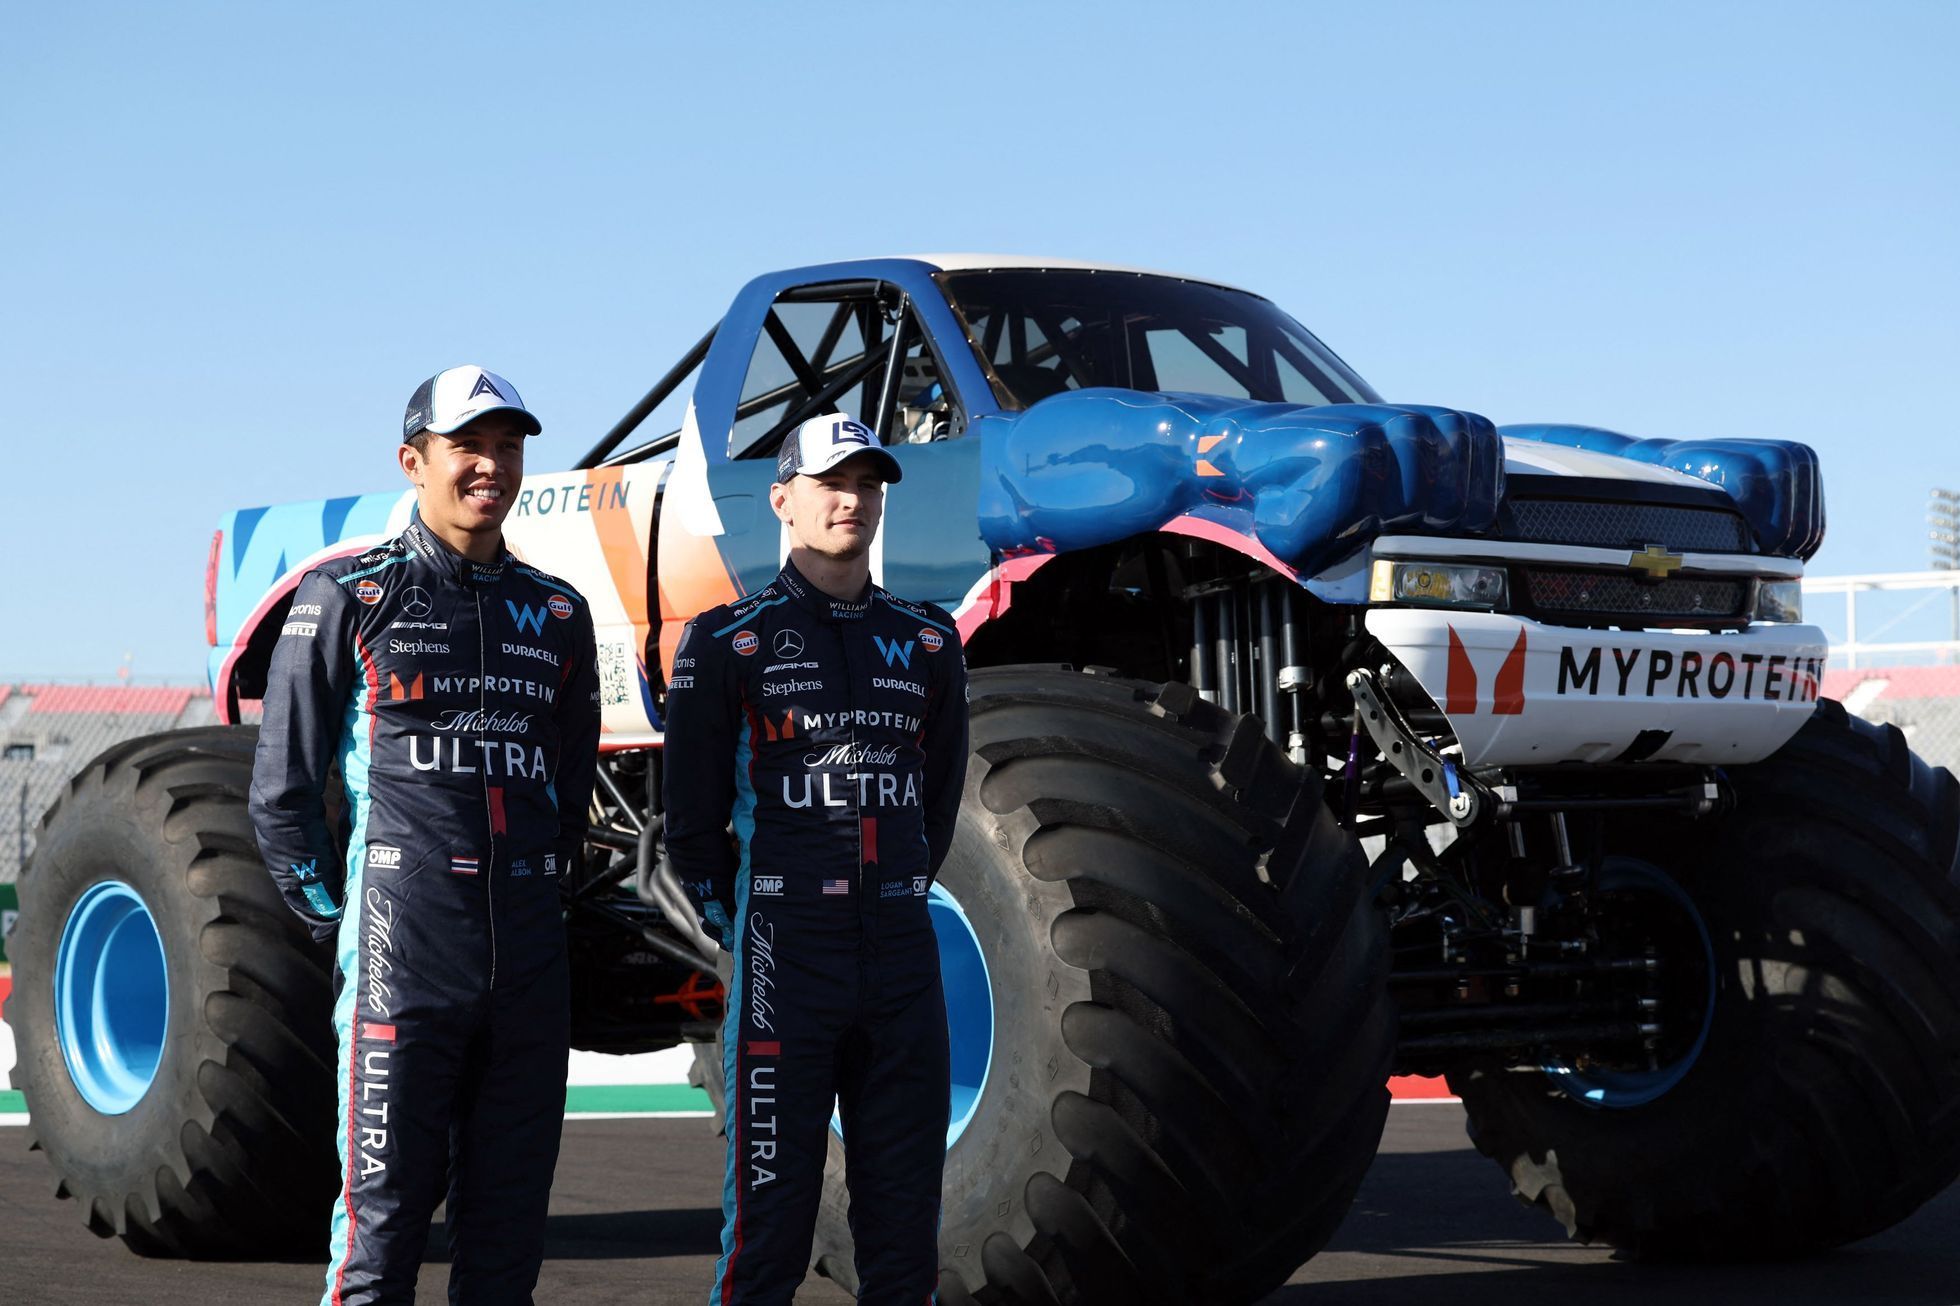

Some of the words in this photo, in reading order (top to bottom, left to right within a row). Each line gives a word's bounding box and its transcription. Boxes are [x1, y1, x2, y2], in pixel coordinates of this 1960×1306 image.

[518, 481, 631, 517] ROTEIN
[472, 574, 501, 583] RACIN
[356, 587, 381, 596] Gulf
[550, 602, 572, 612] Gulf
[832, 610, 864, 620] RACING
[408, 621, 448, 631] AMG
[389, 638, 450, 656] Stephens
[502, 643, 559, 667] DURACELL
[734, 637, 758, 649] Gulf
[782, 661, 819, 670] AMG
[1558, 644, 1827, 702] MYPROTEIN
[433, 675, 555, 704] MYPROTEIN
[762, 678, 823, 697] Stephens
[872, 678, 925, 698] DURACELL
[430, 708, 535, 734] Michelob
[803, 709, 922, 733] MYPROTEIN
[410, 735, 547, 782] ULTRA
[803, 740, 903, 767] Michelob
[783, 772, 919, 809] ULTRA
[368, 849, 401, 865] OMP
[754, 879, 784, 892] OMP
[366, 886, 394, 1018] Michelob
[750, 911, 775, 1034] Michelob
[360, 1050, 390, 1181] ULTRA
[751, 1066, 777, 1192] ULTRA
